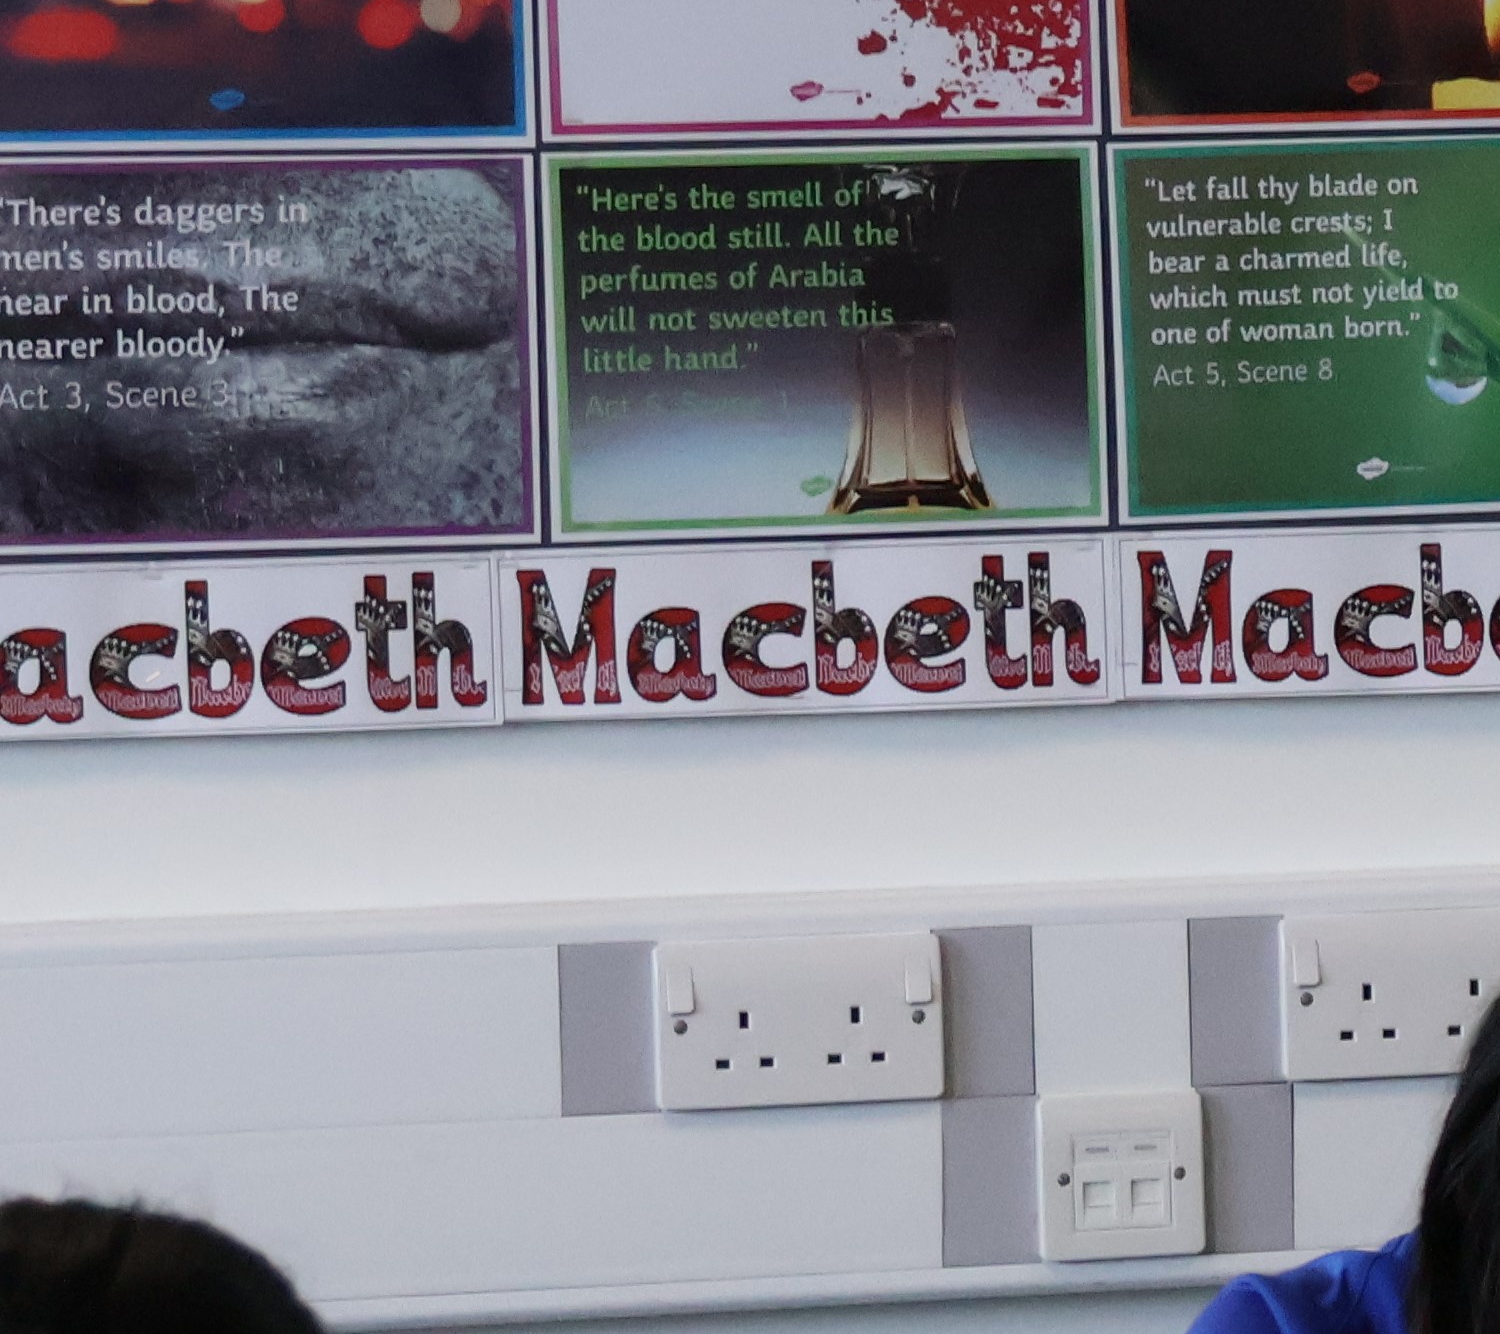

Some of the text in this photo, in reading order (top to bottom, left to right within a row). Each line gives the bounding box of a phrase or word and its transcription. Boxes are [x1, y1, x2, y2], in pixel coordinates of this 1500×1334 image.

[688, 183, 737, 210] the
[746, 180, 823, 210] smell
[835, 180, 864, 207] of
[1207, 175, 1249, 201] fall
[1258, 175, 1298, 205] thy
[1309, 173, 1378, 197] blade
[1387, 176, 1419, 195] on
[134, 195, 309, 233] daggers in
[1147, 211, 1373, 238] vulnerable crests;
[578, 220, 900, 253] the blood still. All the
[222, 240, 283, 269] The
[1148, 242, 1408, 274] bear a charmed life,
[581, 261, 866, 300] perfumes of Arabia
[1149, 276, 1459, 310] which must not yield to
[82, 284, 300, 319] in blood, The
[581, 300, 896, 334] will not sweeten this
[1151, 326, 1198, 346] one
[1206, 318, 1232, 344] of
[1240, 320, 1335, 342] woman
[584, 345, 653, 374] little
[1153, 358, 1334, 388] Act 5, Scene 8
[0, 379, 199, 414] Act 3, Scene
[516, 551, 1102, 708] Macbeth
[0, 573, 488, 724] acbeth
